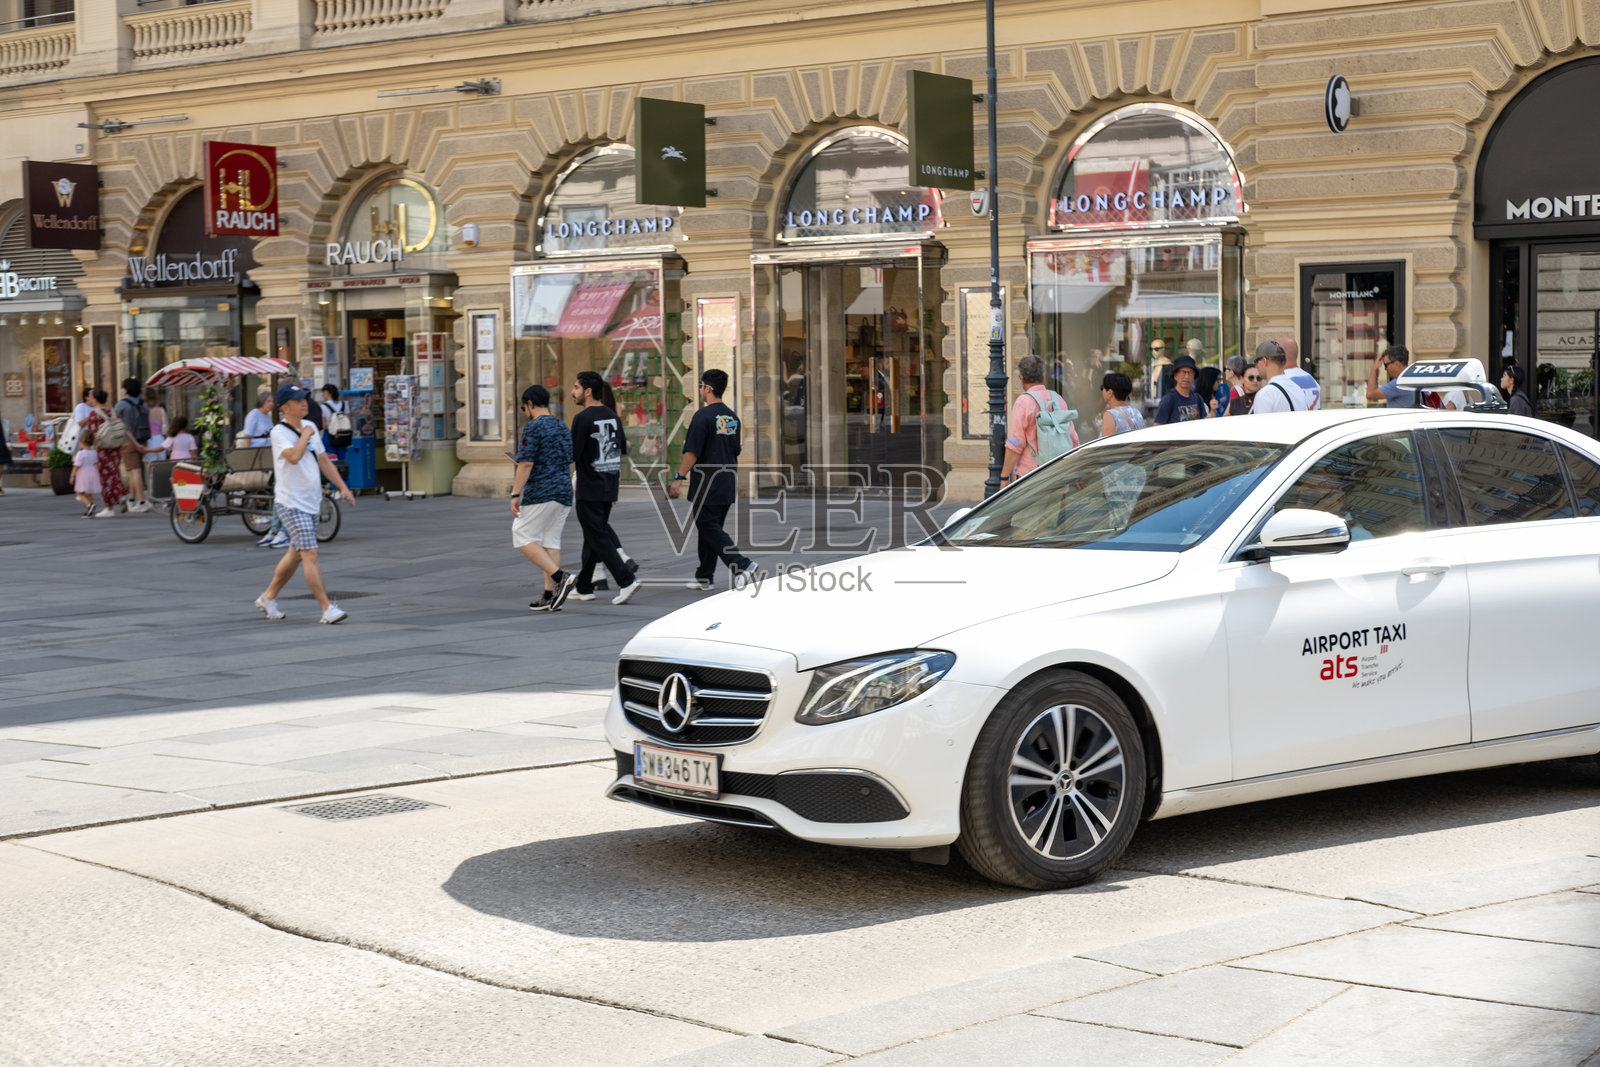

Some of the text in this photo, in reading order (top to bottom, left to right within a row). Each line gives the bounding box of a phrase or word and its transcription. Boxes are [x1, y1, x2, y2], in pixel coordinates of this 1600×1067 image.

[922, 164, 969, 178] LONGCHAMP
[1063, 188, 1228, 213] LONGCHAMP
[32, 214, 98, 231] Wellendorff
[215, 210, 275, 231] RAUCH
[788, 204, 931, 227] LONGCHAMP
[548, 217, 674, 239] LONGCHAMP
[326, 239, 403, 266] RAUCH
[128, 249, 239, 283] Wellendorff
[1329, 290, 1374, 299] MONTBLANC
[1412, 363, 1460, 374] TAXI
[1302, 623, 1406, 656] AIRPORT TAXI
[1320, 654, 1358, 680] ats
